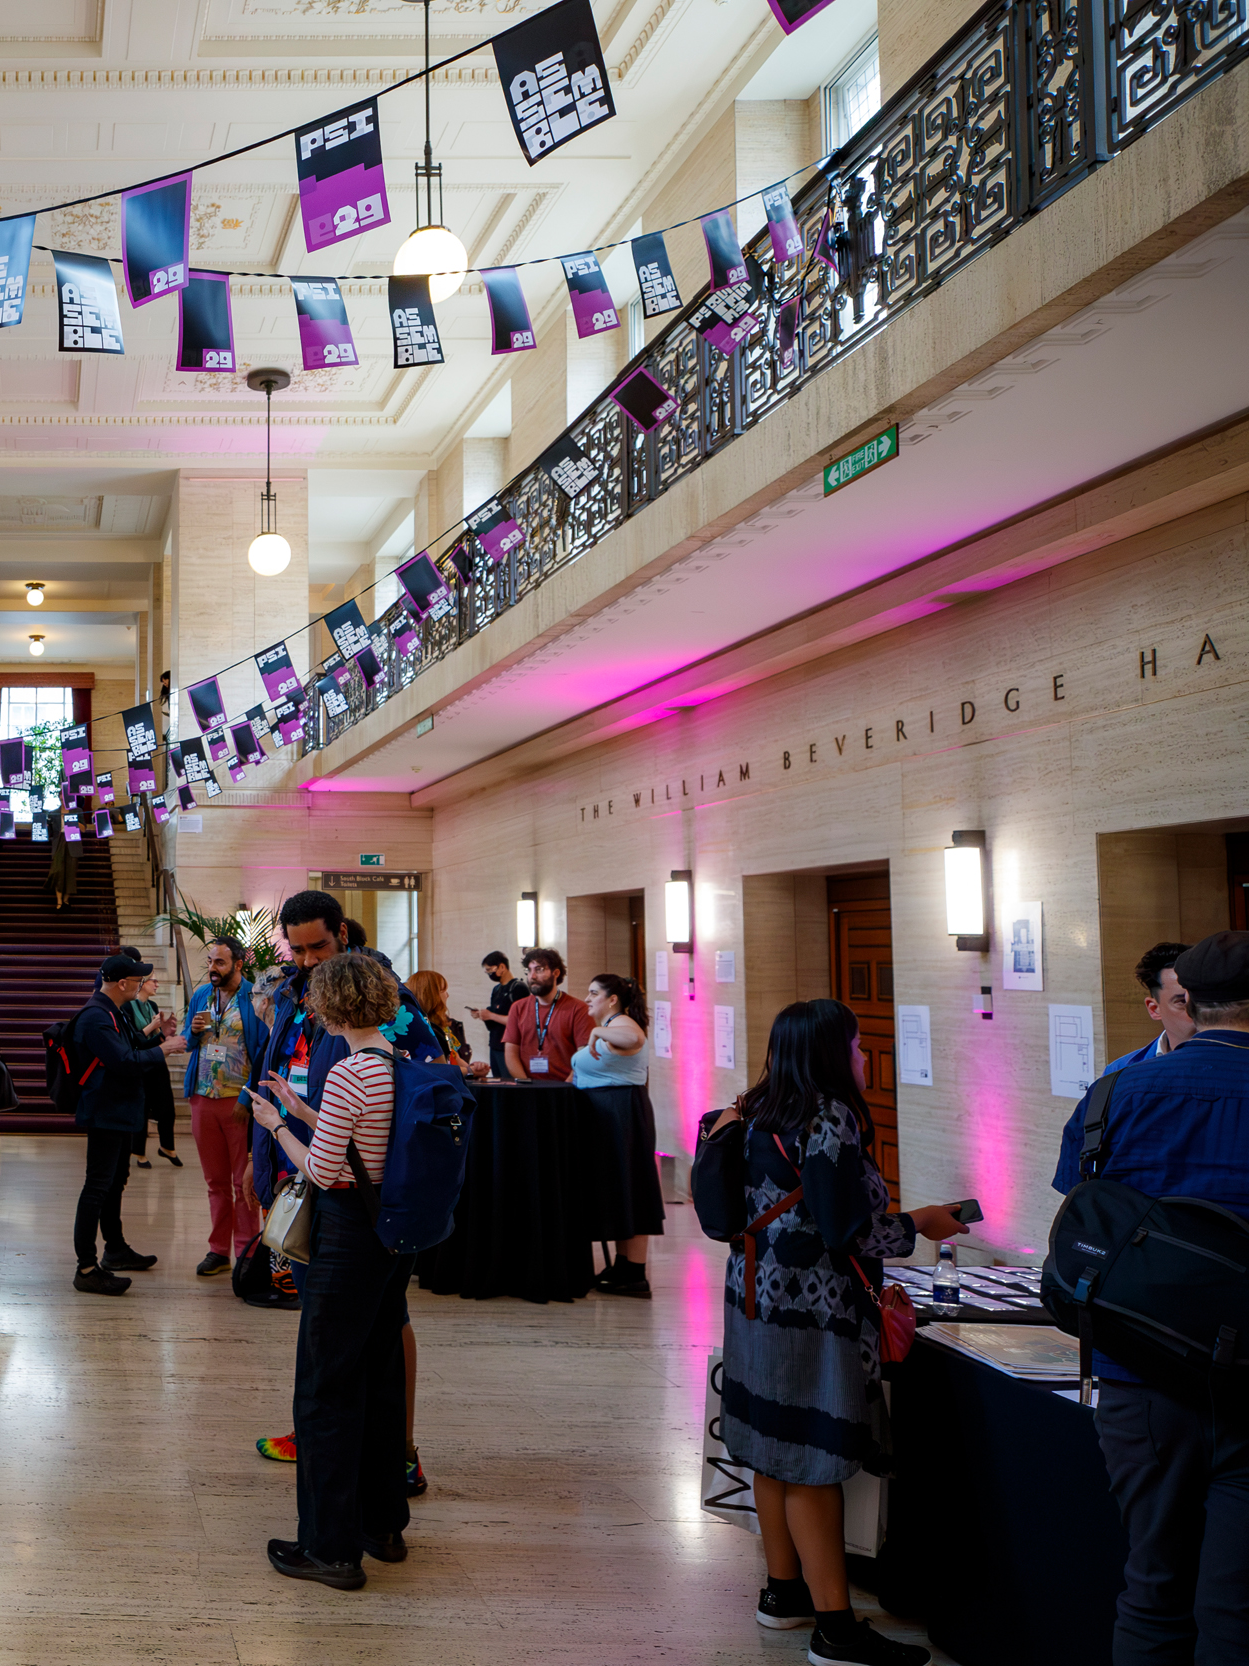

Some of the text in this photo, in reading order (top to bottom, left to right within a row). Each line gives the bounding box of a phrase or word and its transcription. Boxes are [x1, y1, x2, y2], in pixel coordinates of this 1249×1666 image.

[509, 51, 568, 103] AS
[515, 63, 603, 130] SEM
[300, 107, 373, 159] PSI
[521, 96, 610, 159] BLE
[764, 187, 788, 210] PSI
[333, 192, 385, 236] 29
[786, 234, 803, 255] 29
[565, 256, 599, 279] PSI
[639, 262, 659, 281] AS
[729, 266, 746, 283] 29
[152, 263, 184, 293] 29
[642, 275, 672, 296] SEM
[296, 281, 340, 301] PSI
[646, 292, 680, 316] BLE
[63, 304, 118, 328] SEM
[393, 307, 420, 327] AS
[592, 308, 618, 330] 29
[63, 325, 121, 350] BLE
[397, 325, 437, 346] SEM
[731, 316, 755, 342] 29
[512, 331, 534, 348] 29
[206, 351, 232, 368] 29
[324, 343, 355, 363] 29
[397, 345, 441, 363] BLE
[656, 400, 676, 419] 29
[852, 450, 865, 463] FIRE
[551, 456, 575, 483] AS
[557, 457, 593, 489] SEM
[852, 460, 865, 473] EXIT
[565, 466, 599, 498] BLE
[468, 500, 502, 530] PSI
[500, 529, 523, 551] 29
[430, 586, 447, 603] 29
[333, 621, 354, 640] AS
[390, 615, 407, 633] PSI
[337, 625, 368, 649] SEM
[407, 637, 419, 651] 29
[257, 645, 287, 668] PSI
[341, 637, 371, 660] BLE
[323, 653, 341, 670] PSI
[338, 672, 350, 684] 29
[374, 670, 385, 683] 29
[278, 677, 298, 695] 29
[324, 689, 336, 700] AS
[326, 693, 345, 708] SEM
[328, 701, 349, 717] BLE
[276, 702, 295, 718] PSI
[210, 713, 225, 727] 29
[61, 727, 86, 742] PSI
[127, 722, 144, 737] AS
[129, 730, 156, 746] SEM
[291, 728, 304, 741] 29
[132, 740, 156, 756] BLE
[218, 748, 229, 758] 29
[249, 752, 261, 762] 29
[579, 799, 614, 822] THE
[633, 762, 750, 809] WILLIAM
[783, 675, 1066, 770] BEVERIDGE
[72, 759, 88, 772] 29
[184, 753, 198, 765] AS
[186, 760, 208, 773] SEM
[11, 774, 23, 783] 29
[97, 774, 112, 783] PSI
[139, 780, 155, 790] 29
[187, 770, 210, 782] BLE
[80, 786, 94, 794] 29
[104, 794, 114, 802] 29
[1078, 1242, 1106, 1255] TIMBUK2
